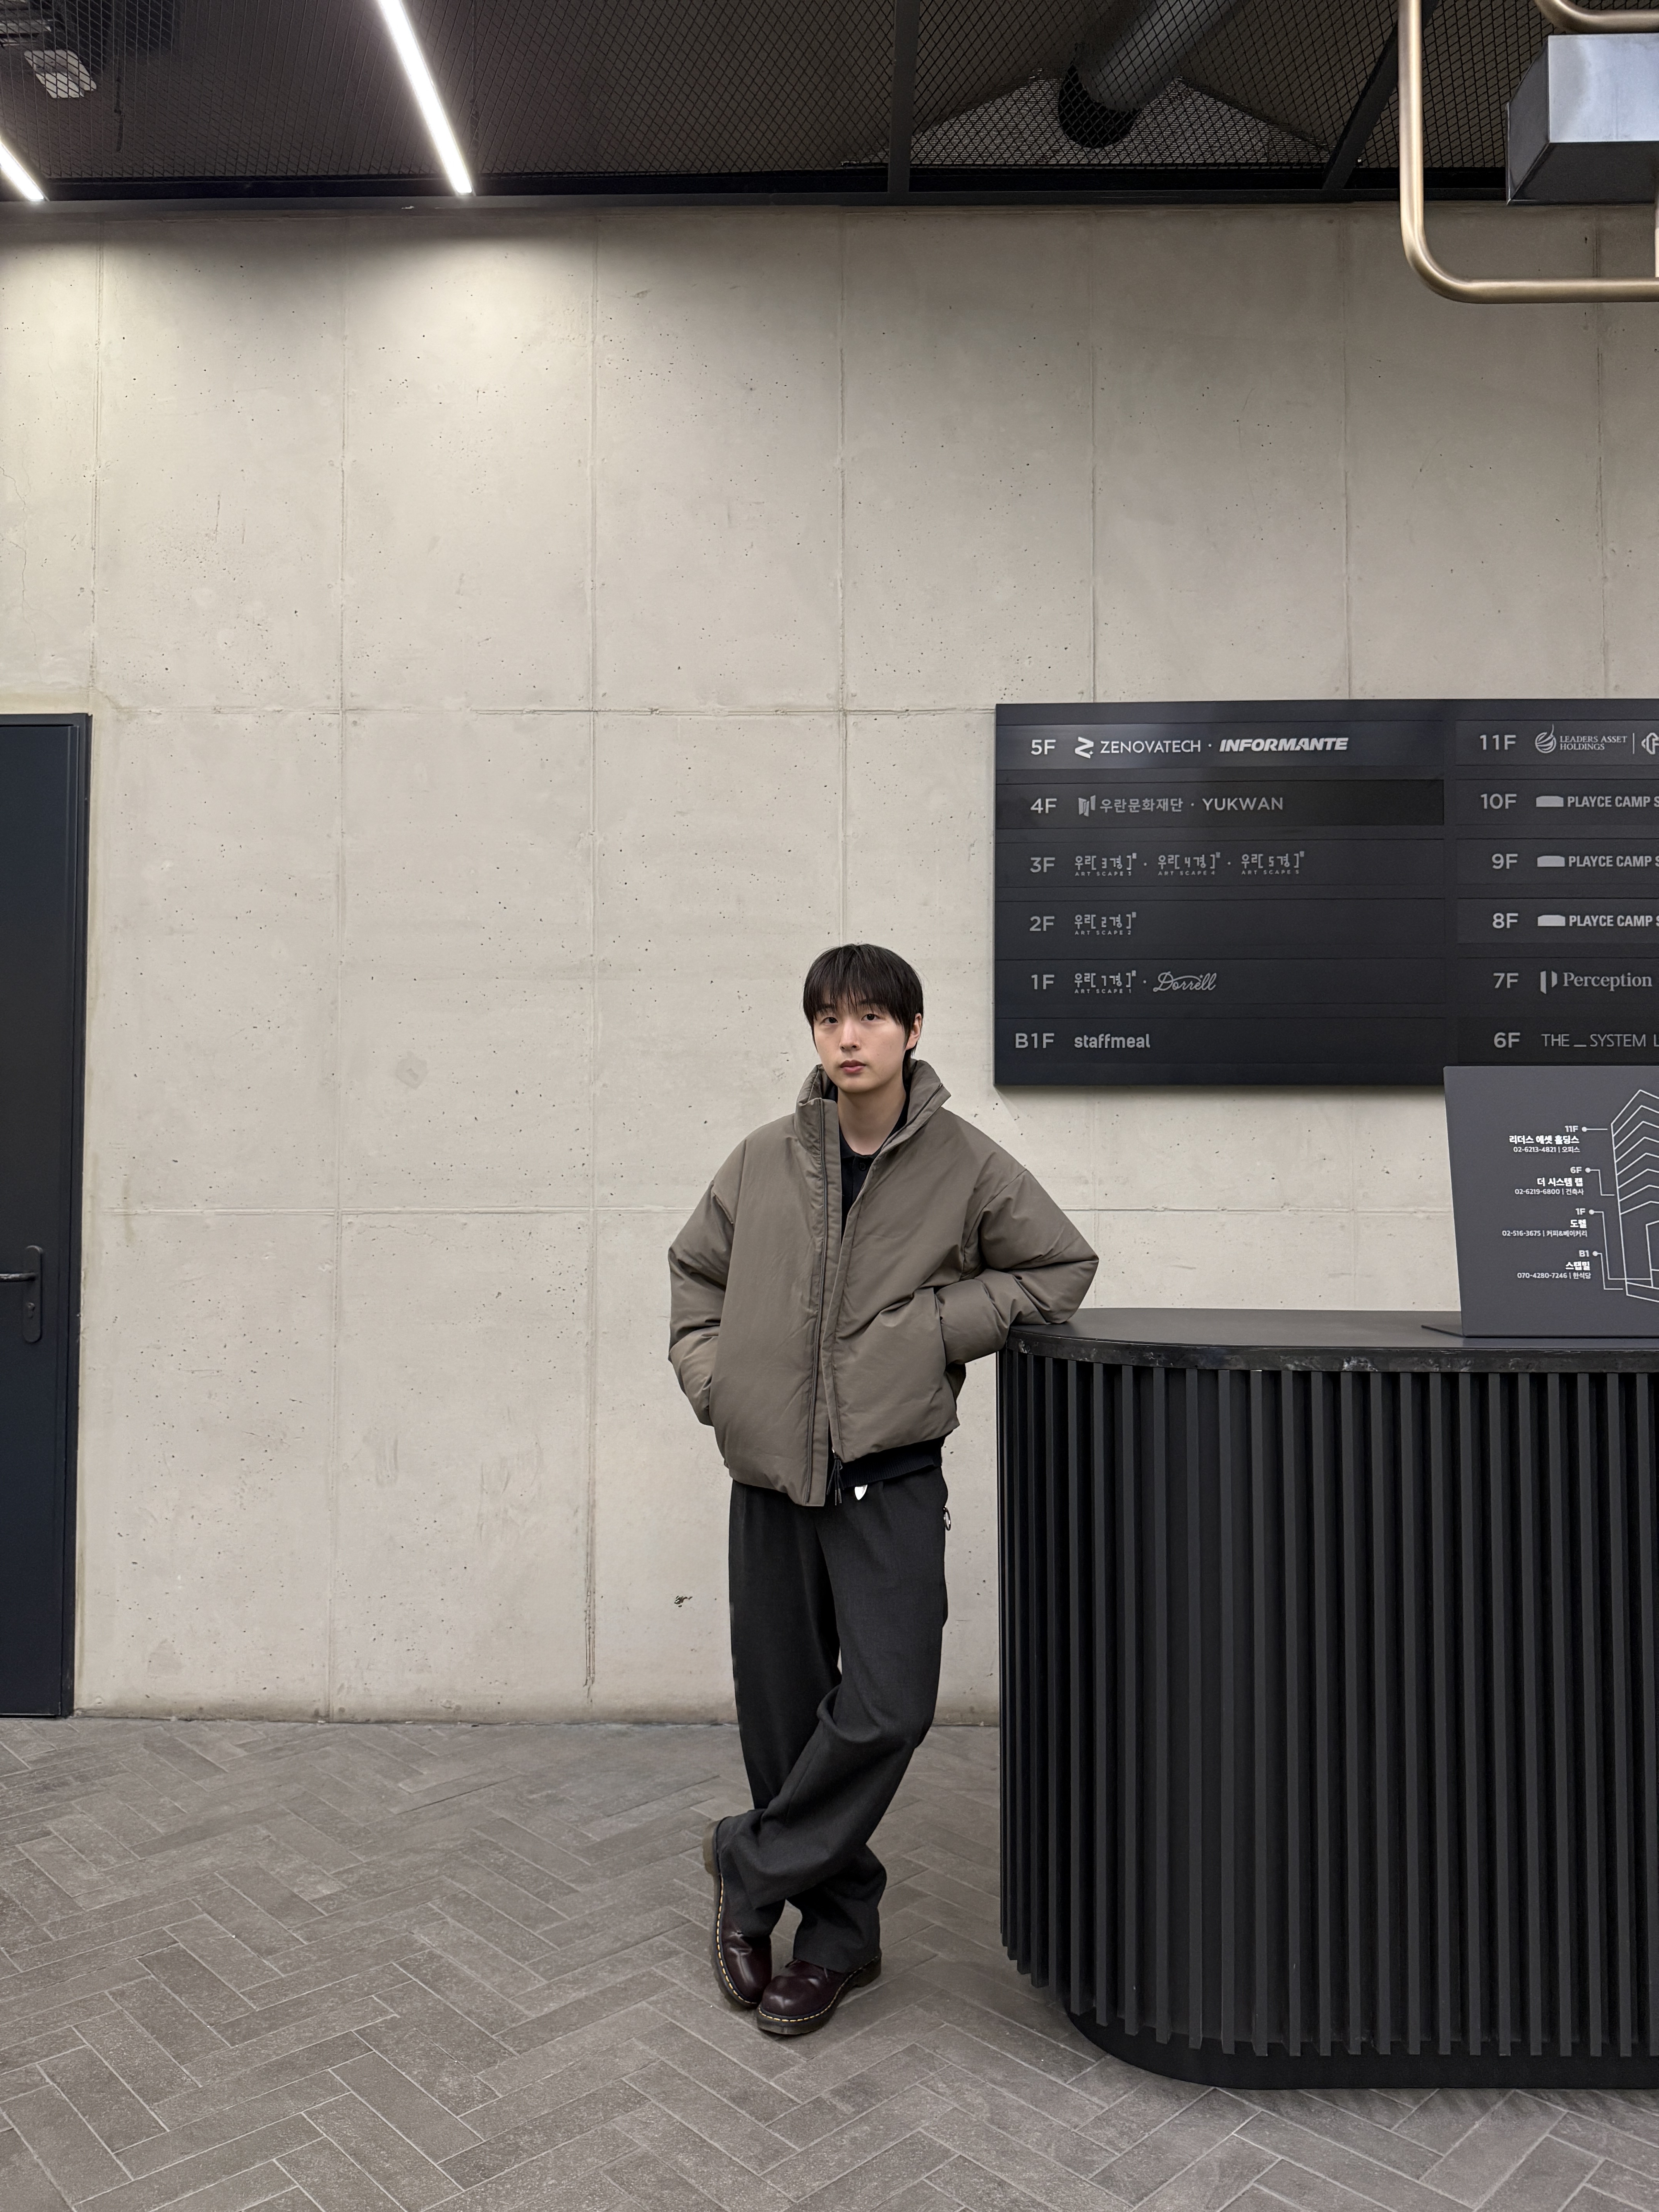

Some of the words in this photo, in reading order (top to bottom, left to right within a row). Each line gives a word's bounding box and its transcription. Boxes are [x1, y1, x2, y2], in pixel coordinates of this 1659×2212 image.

[1031, 739, 1056, 755] 5F
[1100, 740, 1200, 754] ZENOVATECH
[1219, 737, 1349, 752] INFORMANTE
[1480, 734, 1516, 750] 11F
[1030, 798, 1057, 814] 4F
[1100, 798, 1183, 813] 우란문화재단
[1202, 797, 1283, 811] YUKWAN
[1480, 793, 1517, 809] 10F
[1567, 796, 1612, 807] PLAYCE
[1615, 796, 1650, 807] CAMP
[1030, 857, 1055, 873] 3F
[1492, 854, 1518, 869] 9F
[1568, 855, 1613, 867] PLAYCE
[1616, 855, 1652, 867] CAMP
[1029, 916, 1055, 931] 2F
[1492, 913, 1518, 929] 8F
[1569, 915, 1614, 927] PLAYCE
[1617, 915, 1653, 927] CAMP
[1031, 974, 1055, 990] 1F
[1152, 971, 1217, 992] Dorrell
[1493, 973, 1519, 988] 7F
[1563, 972, 1652, 991] Perception
[1015, 1033, 1054, 1048] B1F
[1074, 1033, 1151, 1048] staffmeal
[1494, 1032, 1520, 1048] 6F
[1509, 1135, 1534, 1144] 리더스
[1554, 1135, 1580, 1145] 홀딩스
[1537, 1177, 1546, 1187] 더
[1547, 1177, 1573, 1187] 시스템
[1574, 1177, 1583, 1187] 랩
[1570, 1219, 1587, 1229] 도렐
[1565, 1261, 1590, 1271] 스탭밀
